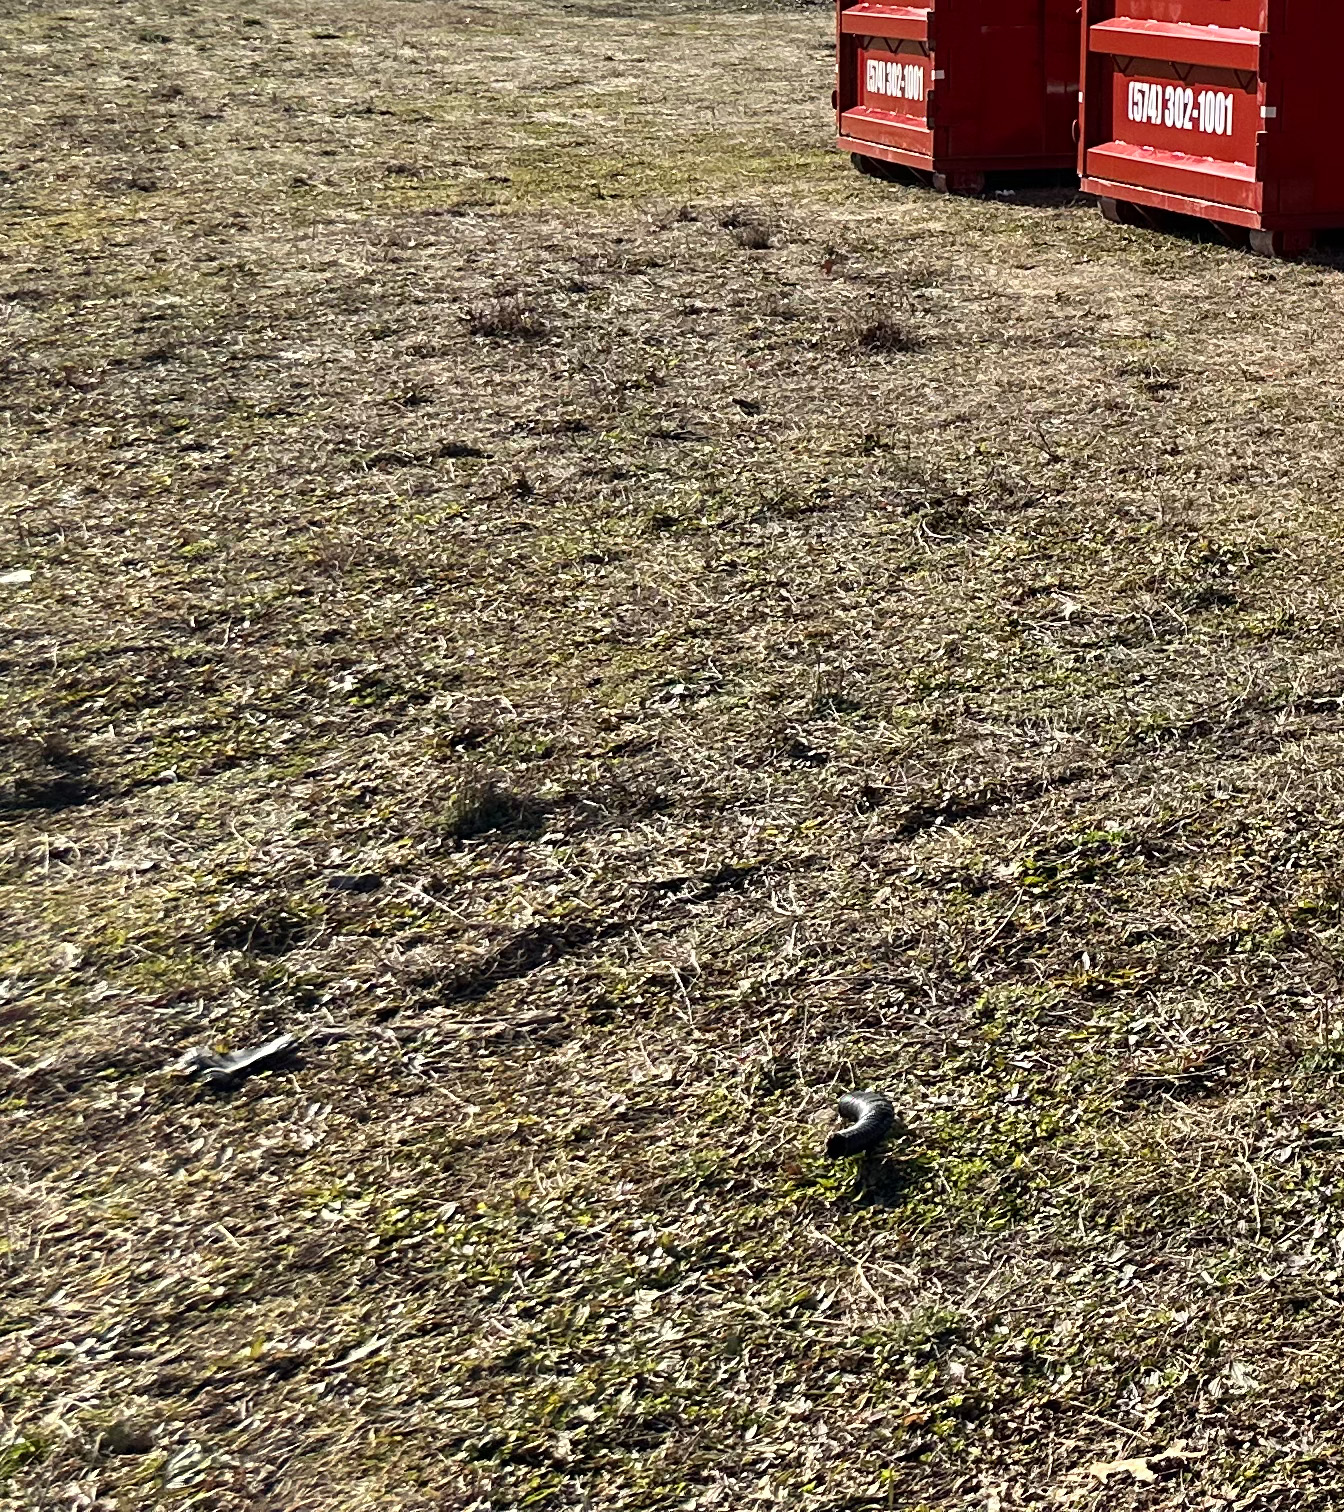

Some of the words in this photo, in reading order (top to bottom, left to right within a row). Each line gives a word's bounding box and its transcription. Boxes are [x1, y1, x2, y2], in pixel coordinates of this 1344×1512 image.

[866, 59, 886, 94] (574)
[886, 61, 924, 101] 302-1001
[1128, 81, 1162, 125] (574)
[1164, 86, 1234, 136] 302-1001
